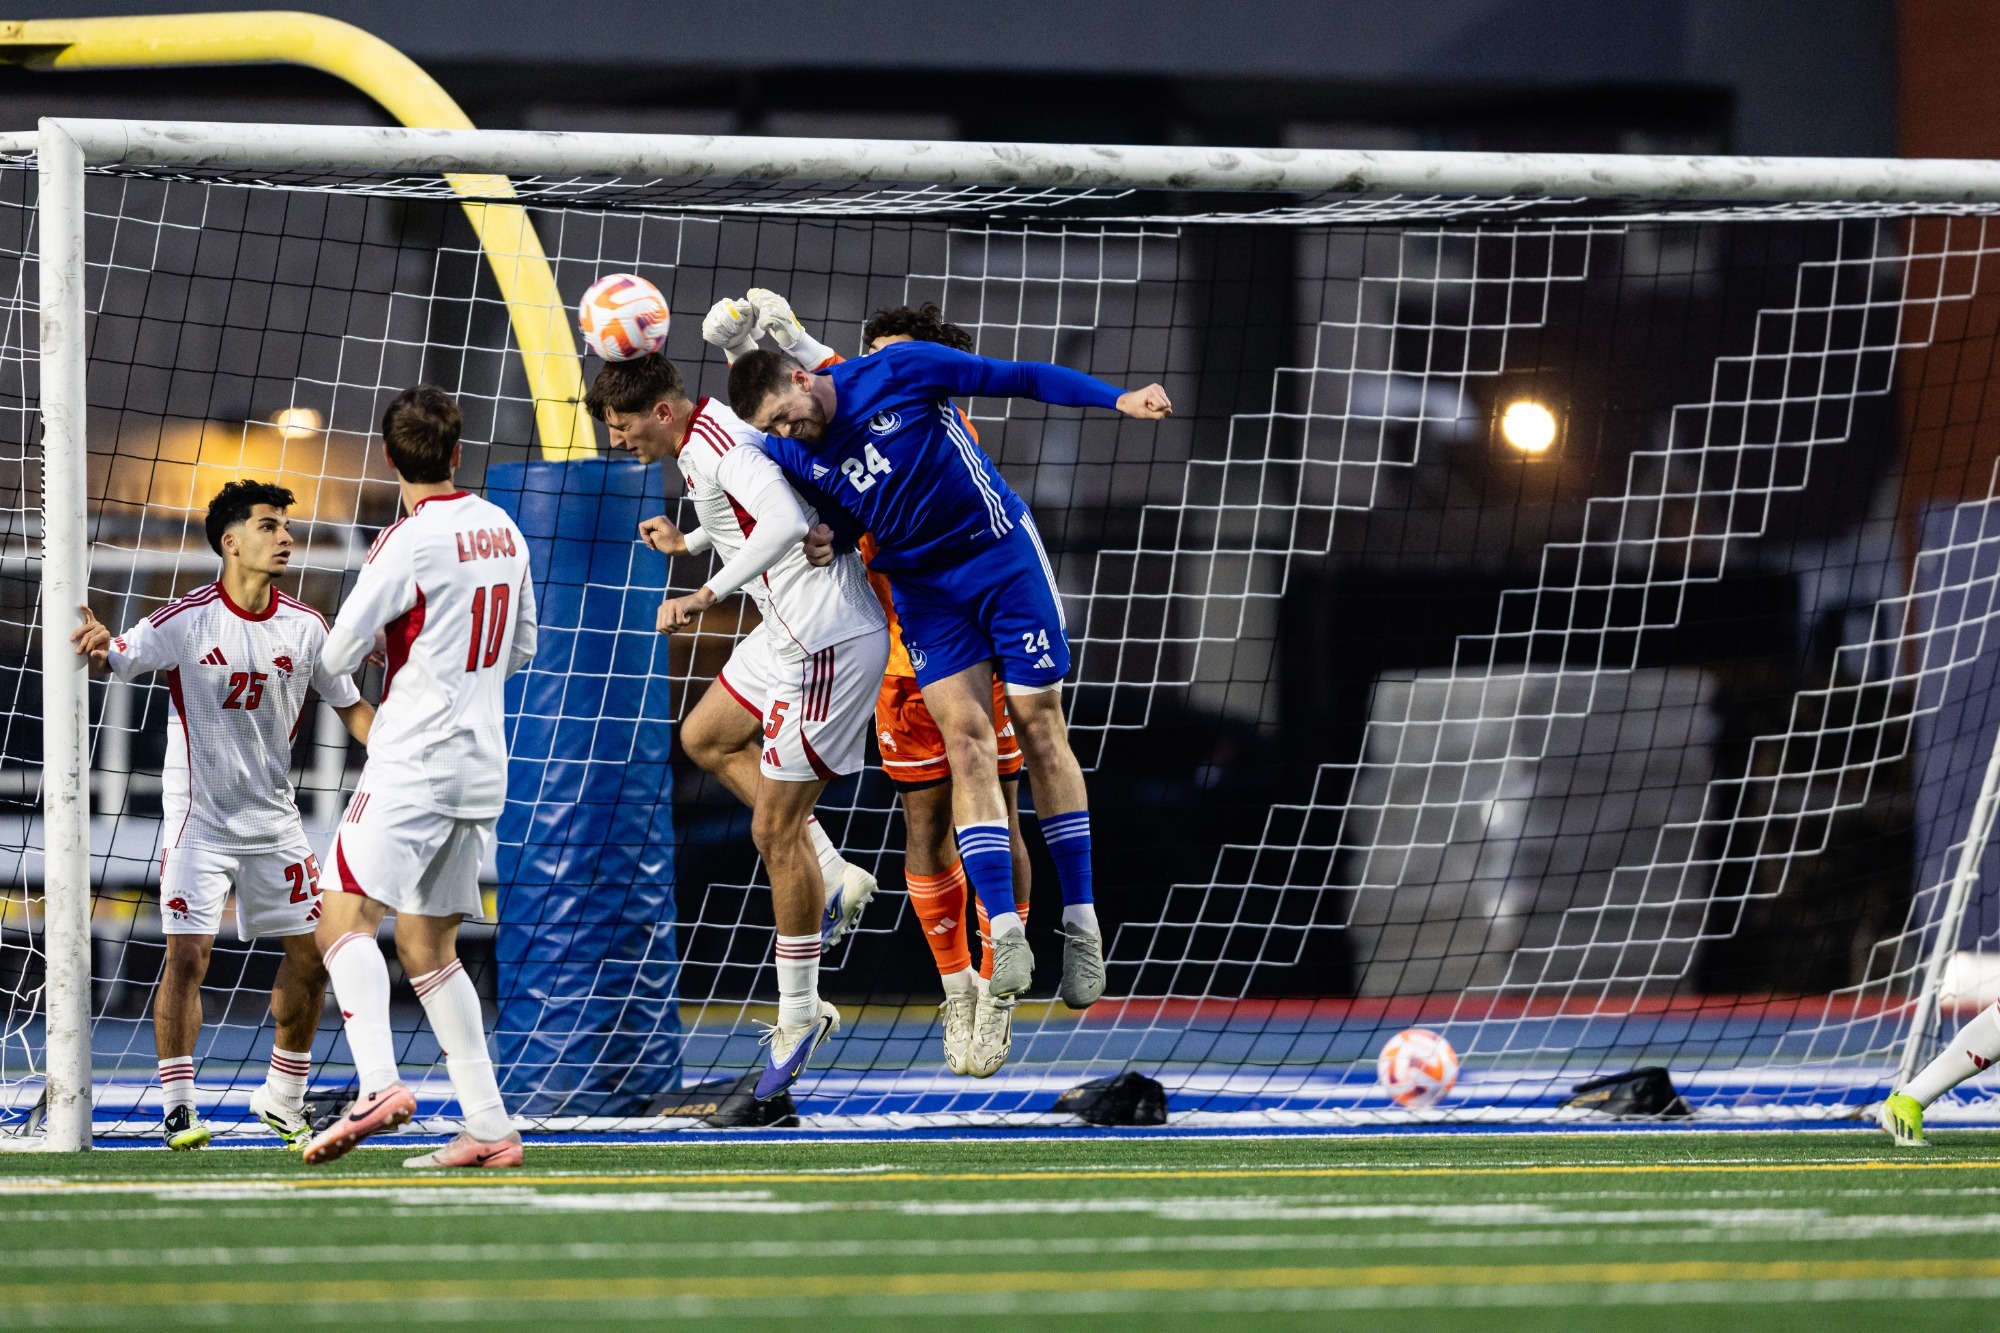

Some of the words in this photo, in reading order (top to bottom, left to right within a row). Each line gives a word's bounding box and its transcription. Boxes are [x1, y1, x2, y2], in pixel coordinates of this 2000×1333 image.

[841, 442, 892, 493] 24
[455, 528, 517, 562] LIONS
[465, 583, 510, 672] 10
[1022, 629, 1050, 653] 24
[222, 672, 268, 710] 25
[765, 700, 790, 739] 5
[284, 853, 324, 905] 25
